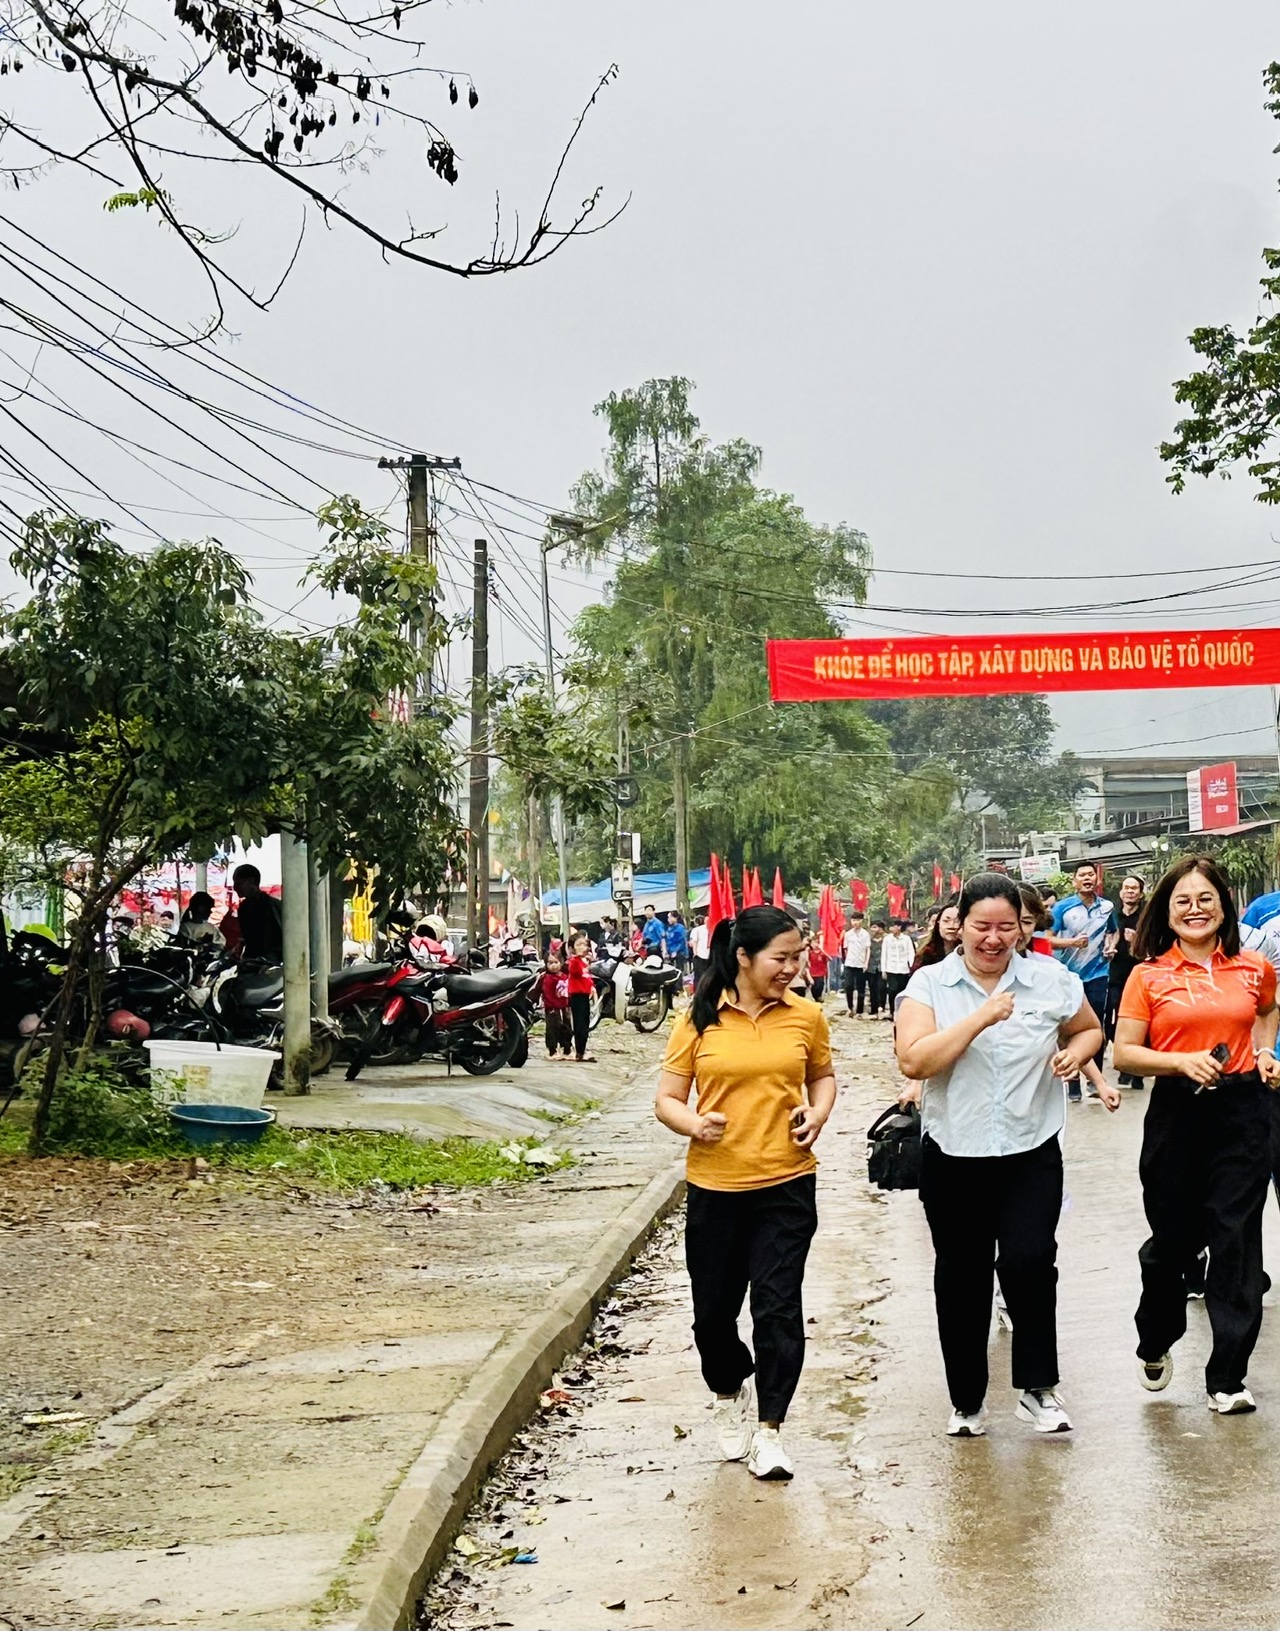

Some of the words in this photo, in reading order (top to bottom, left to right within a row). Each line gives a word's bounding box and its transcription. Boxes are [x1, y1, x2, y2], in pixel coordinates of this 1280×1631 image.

[814, 646, 865, 680] KHỎE
[868, 641, 893, 679] ĐỂ
[895, 653, 934, 683] HỌC
[937, 644, 974, 682] TẬP,
[979, 643, 1016, 675] XÂY
[1020, 646, 1074, 679] DỰNG
[1078, 639, 1103, 671] VÀ
[1108, 636, 1146, 670] BẢO
[1150, 638, 1173, 675] VỆ
[1176, 634, 1202, 668] TỔ
[1203, 632, 1254, 670] QUỐC
